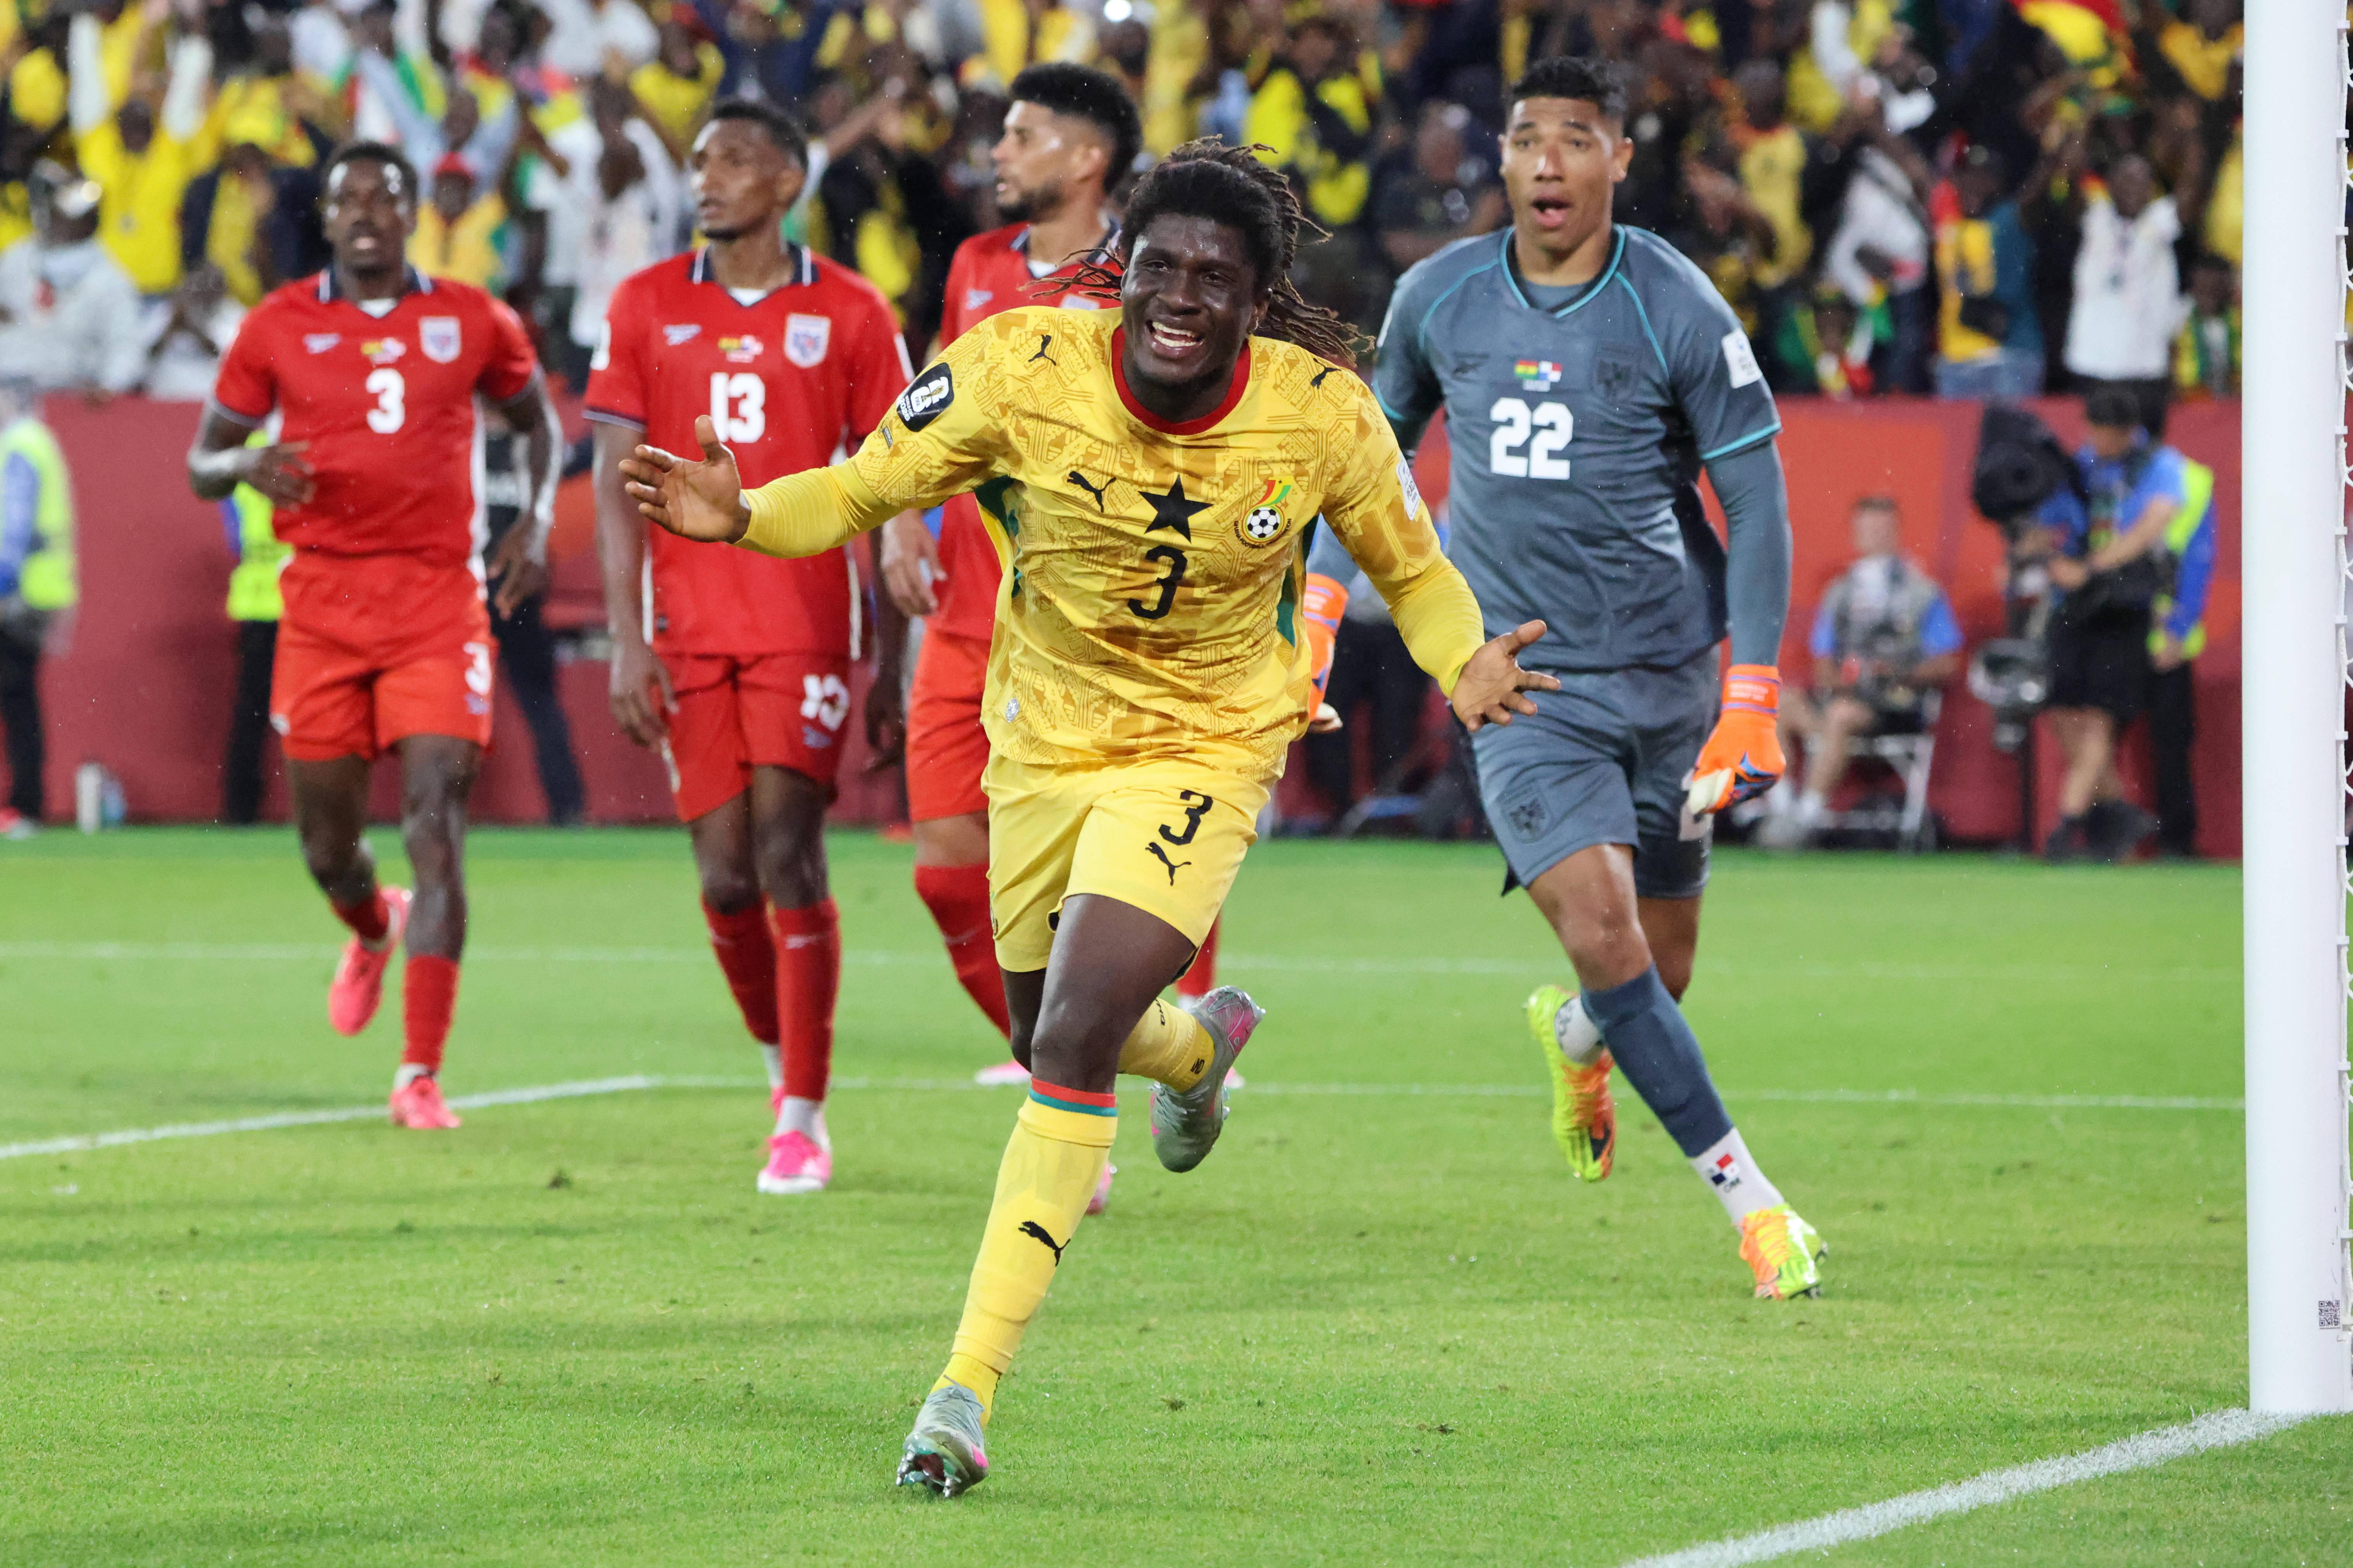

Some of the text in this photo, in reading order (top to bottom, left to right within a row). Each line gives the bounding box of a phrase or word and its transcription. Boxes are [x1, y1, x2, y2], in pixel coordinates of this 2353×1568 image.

[366, 368, 405, 434] 3
[710, 372, 766, 443] 13
[900, 398, 911, 421] 2026
[1490, 397, 1573, 480] 22
[1127, 545, 1188, 620] 3
[1158, 790, 1213, 846] 3
